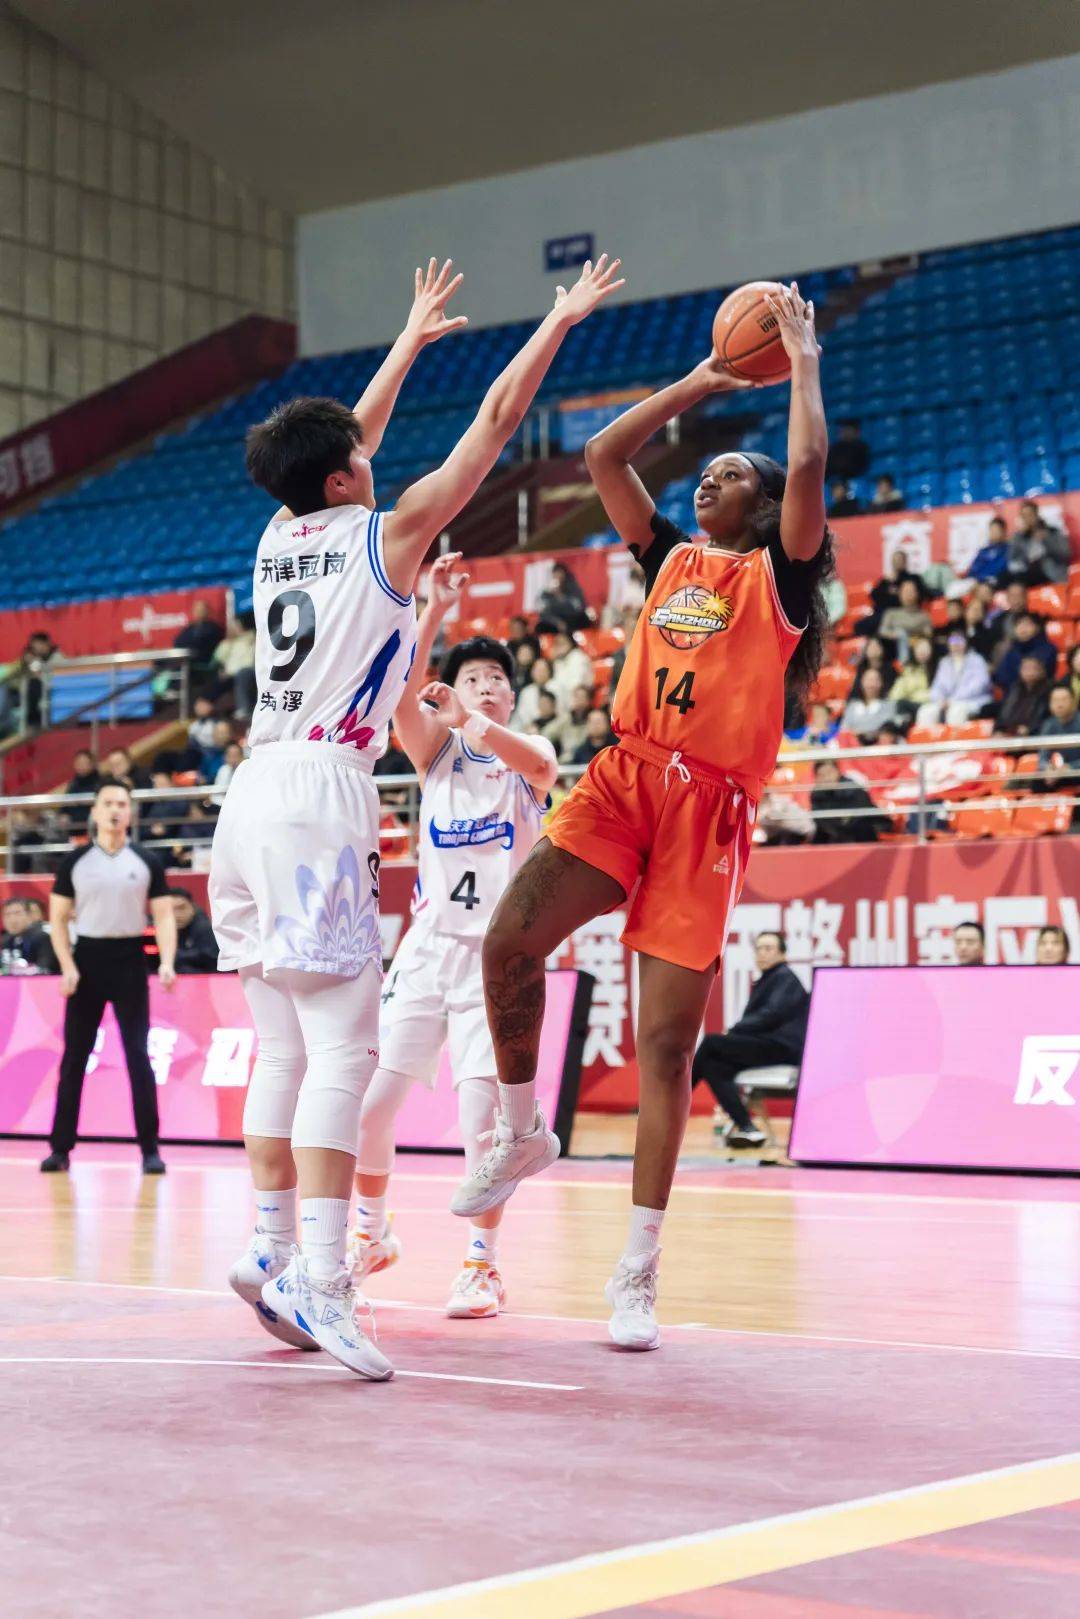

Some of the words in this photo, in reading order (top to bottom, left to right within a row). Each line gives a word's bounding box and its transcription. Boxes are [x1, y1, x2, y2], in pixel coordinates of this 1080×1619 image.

[267, 590, 316, 682] 9
[655, 667, 696, 715] 14
[450, 871, 481, 910] 4
